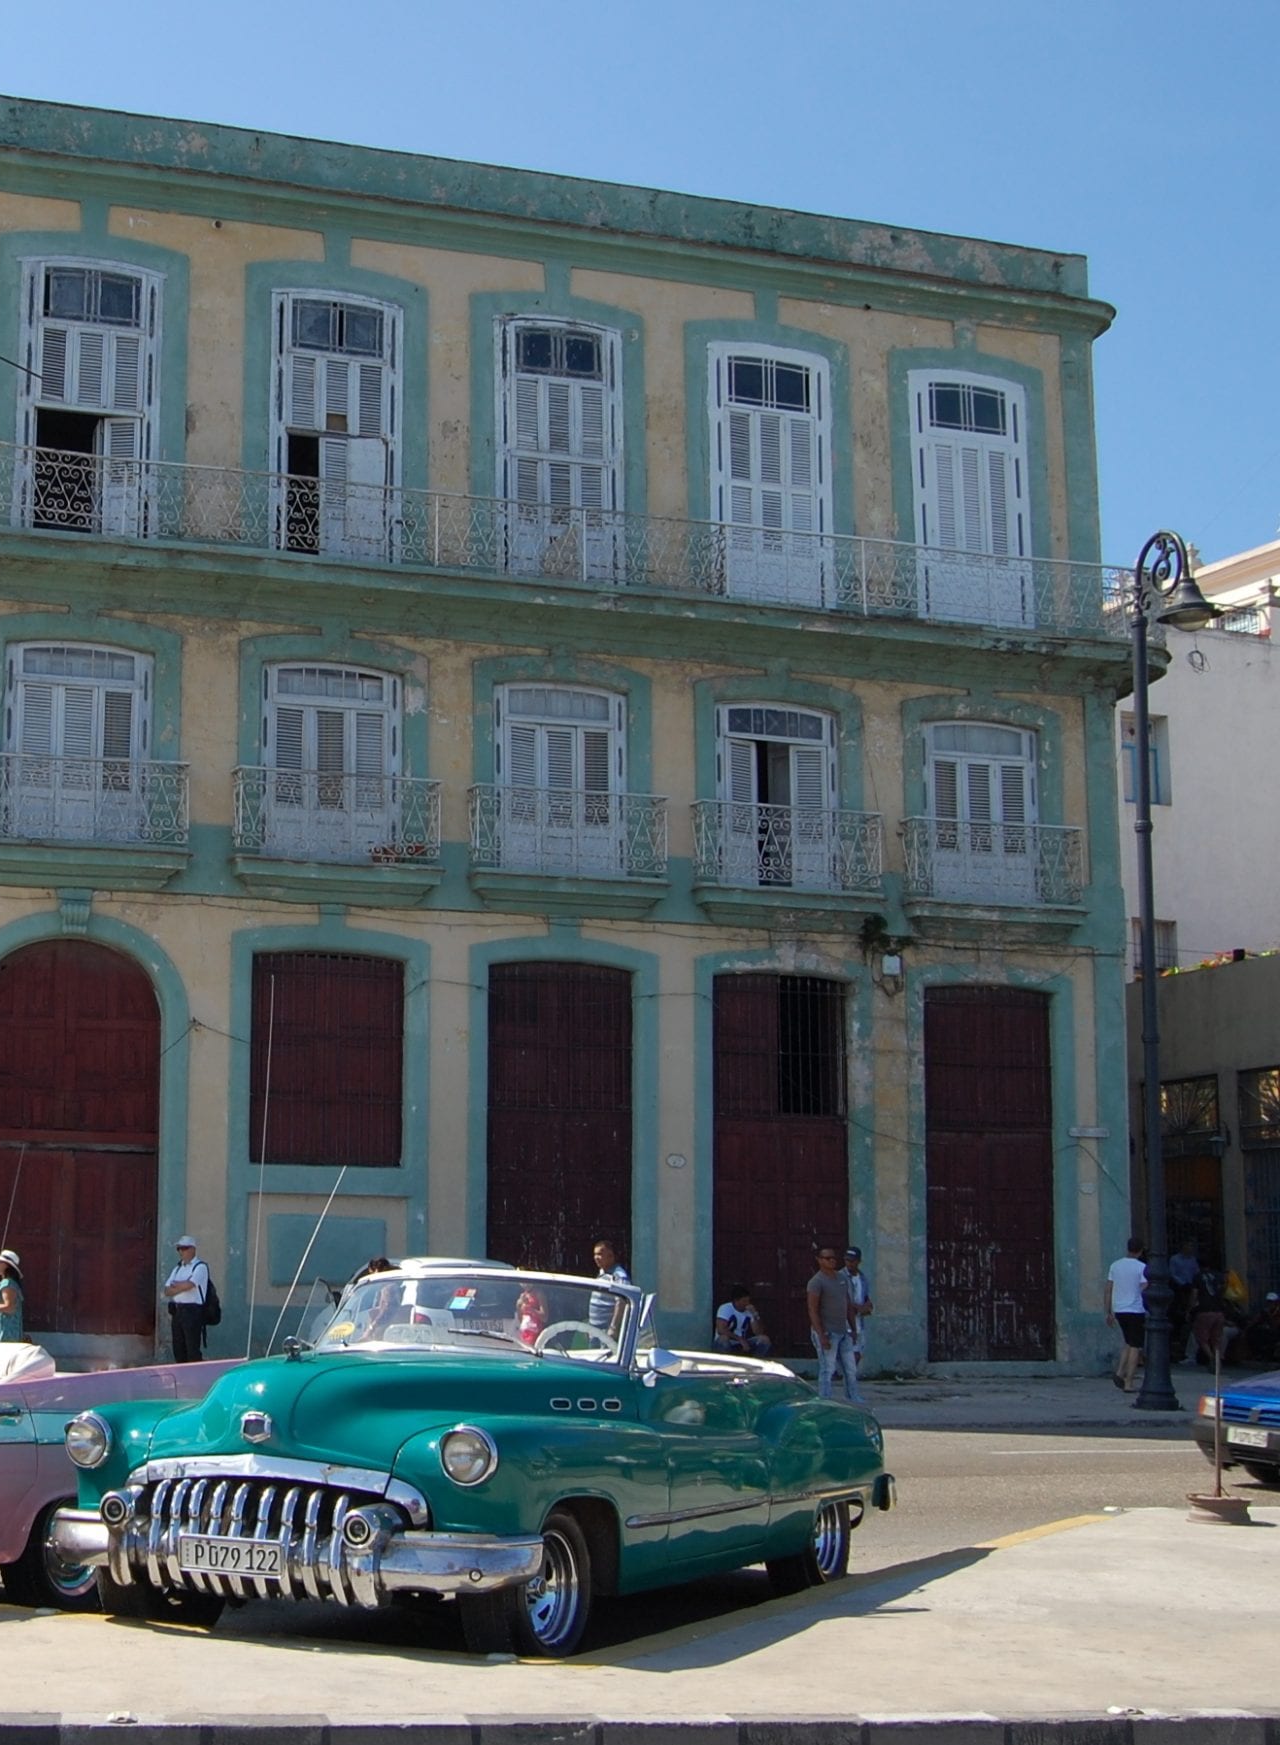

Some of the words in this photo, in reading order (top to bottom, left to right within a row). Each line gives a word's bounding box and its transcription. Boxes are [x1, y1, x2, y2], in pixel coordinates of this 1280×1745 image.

[194, 1543, 205, 1566] P
[208, 1545, 241, 1569] 079
[245, 1548, 279, 1572] 122
